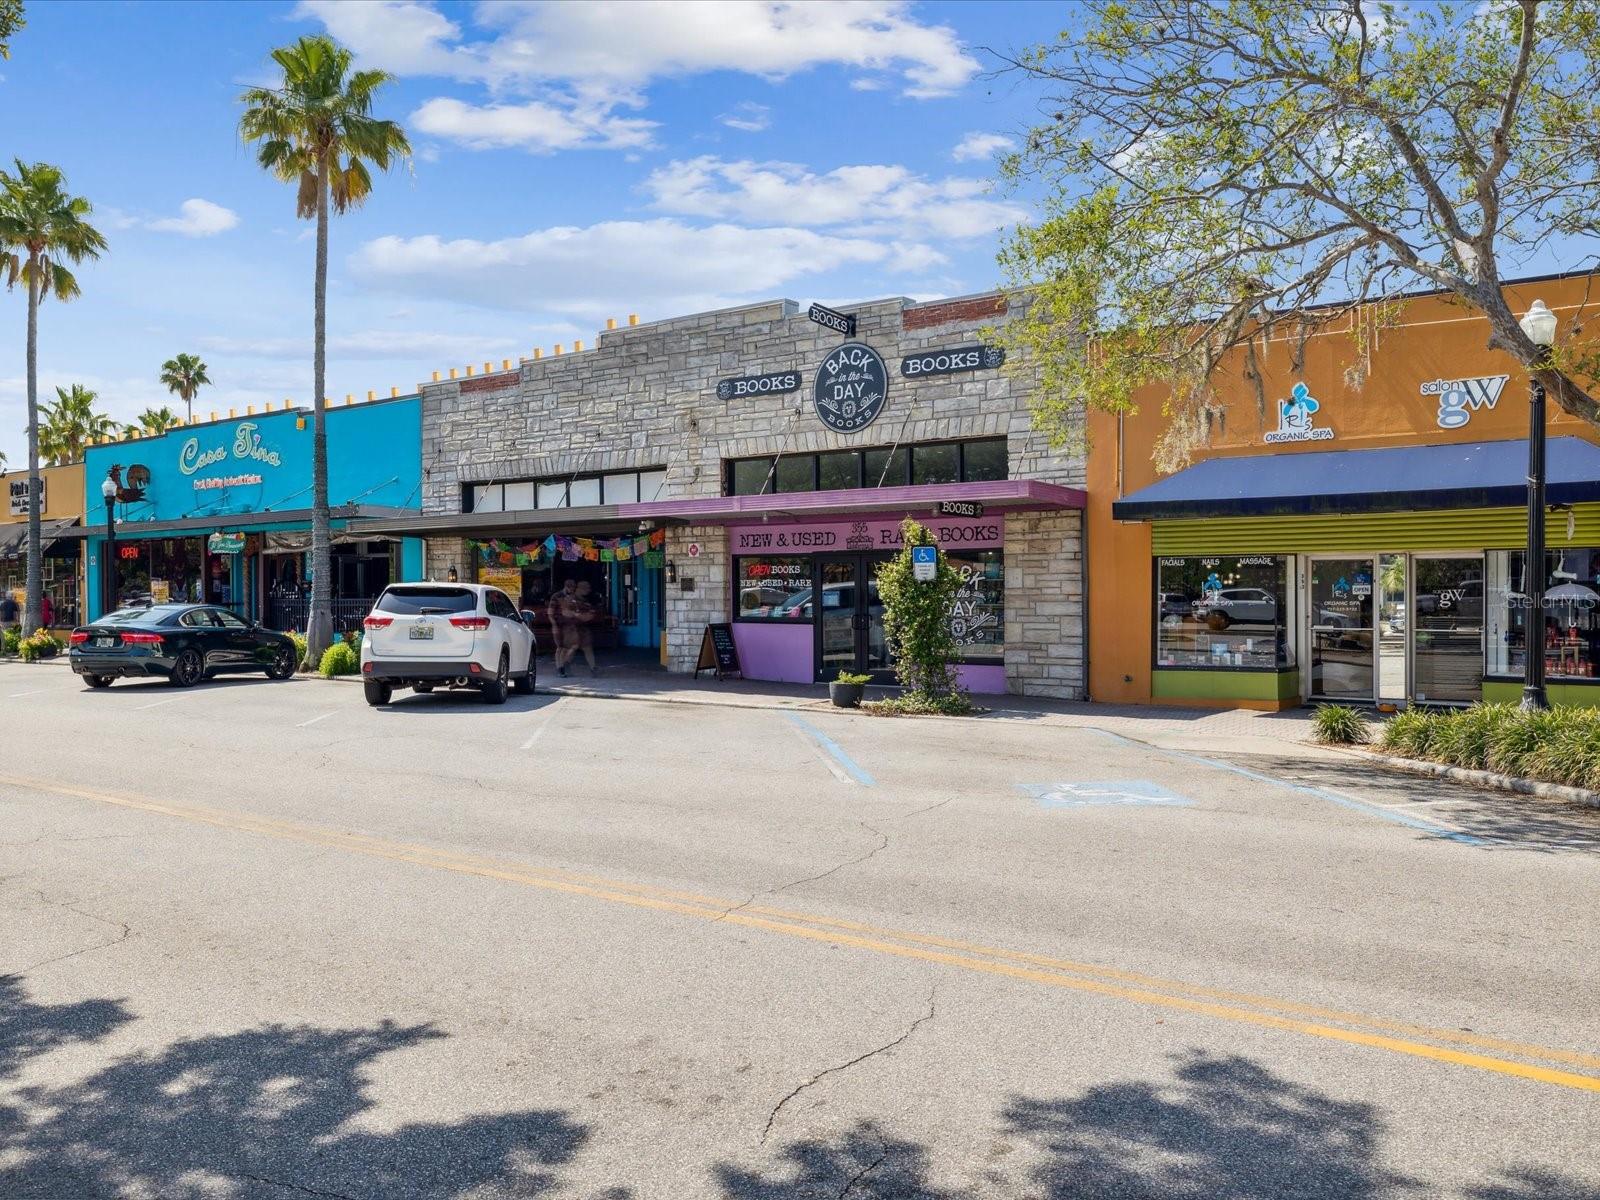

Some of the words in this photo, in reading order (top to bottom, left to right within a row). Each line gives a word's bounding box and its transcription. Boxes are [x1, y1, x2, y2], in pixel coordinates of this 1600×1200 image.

[811, 308, 848, 332] BOOKS
[826, 349, 874, 375] BACK
[905, 351, 980, 374] BOOKS
[838, 373, 847, 382] in
[848, 371, 861, 381] the
[734, 375, 796, 395] BOOKS
[834, 382, 865, 400] DAY
[1422, 380, 1460, 393] salon
[827, 409, 872, 428] BOOKS
[1265, 432, 1309, 442] ORGANIC
[1312, 430, 1332, 439] SPA
[180, 437, 227, 475] Casa
[233, 422, 281, 467] Tina
[942, 501, 975, 515] BOOKS
[739, 533, 773, 548] NEW
[776, 533, 790, 547] &
[791, 531, 837, 546] USED
[938, 526, 999, 543] BOOKS
[121, 547, 139, 559] OPEN
[1161, 559, 1186, 567] FACIALS
[1202, 558, 1220, 566] NAILS
[1239, 557, 1272, 566] MASSAGE
[748, 565, 772, 576] OPEN
[771, 565, 801, 574] BOOKS
[762, 579, 784, 587] USED
[789, 579, 812, 587] RARE
